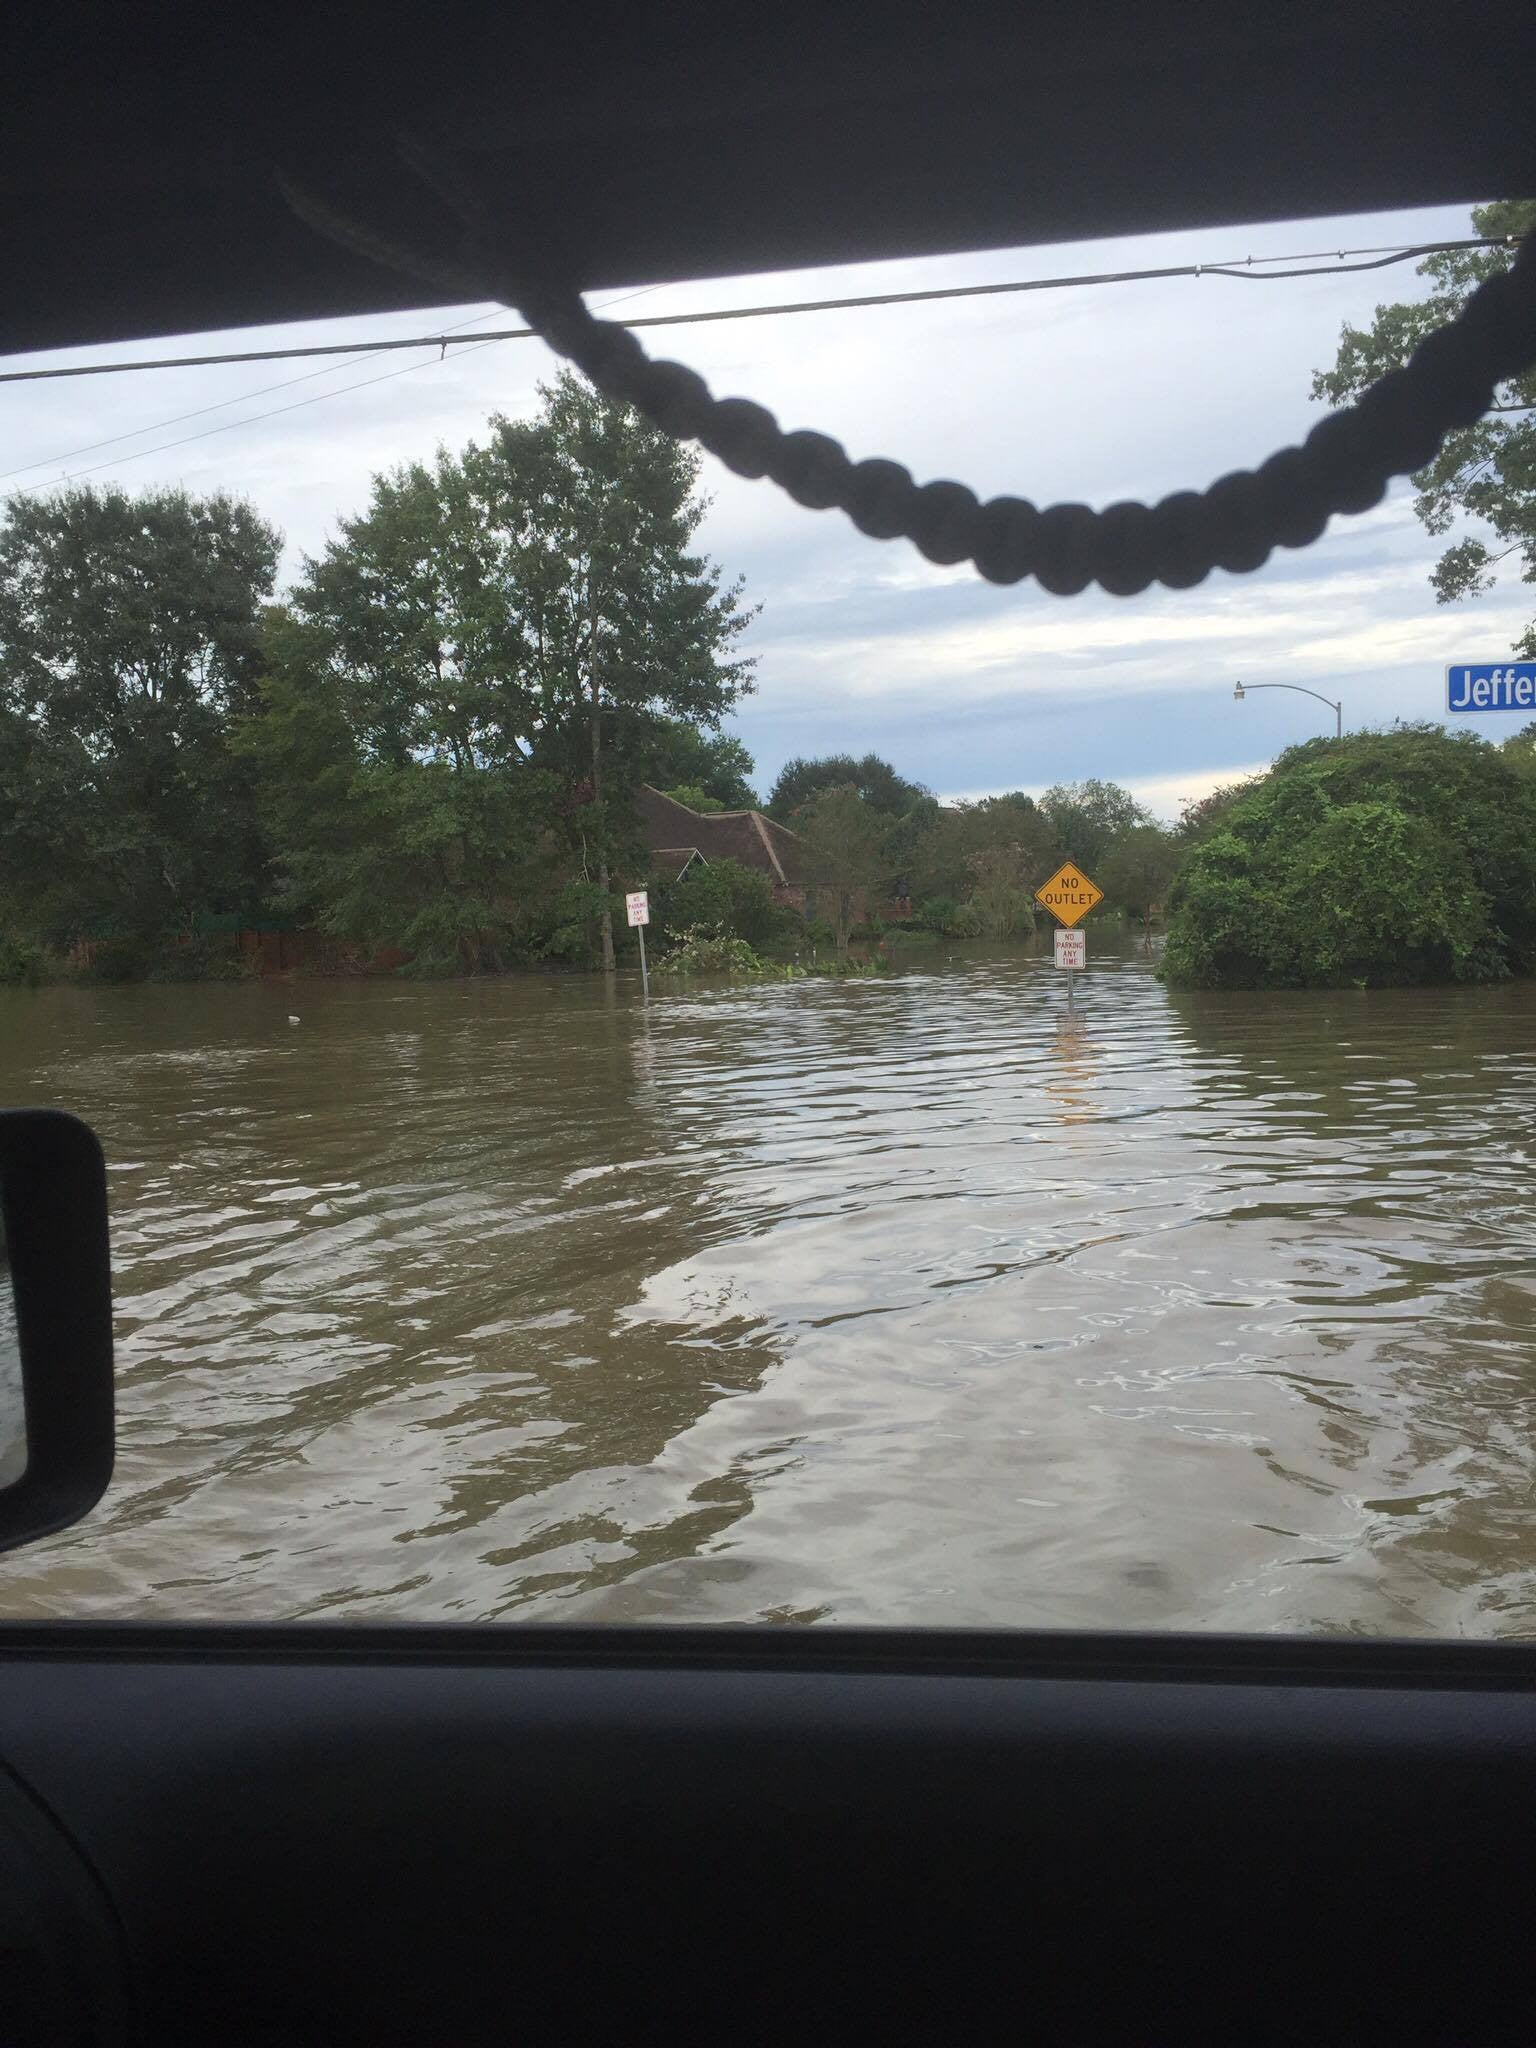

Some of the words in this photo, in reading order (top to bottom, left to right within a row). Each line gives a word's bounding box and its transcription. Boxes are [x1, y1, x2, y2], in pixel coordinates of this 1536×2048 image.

[1452, 668, 1536, 707] Jeffe
[1061, 878, 1079, 889] NO
[1045, 893, 1094, 905] OUTLET
[1064, 933, 1075, 941] NO
[1056, 942, 1084, 950] PARKING
[1062, 950, 1077, 958] ANY
[1062, 958, 1079, 966] TIME
